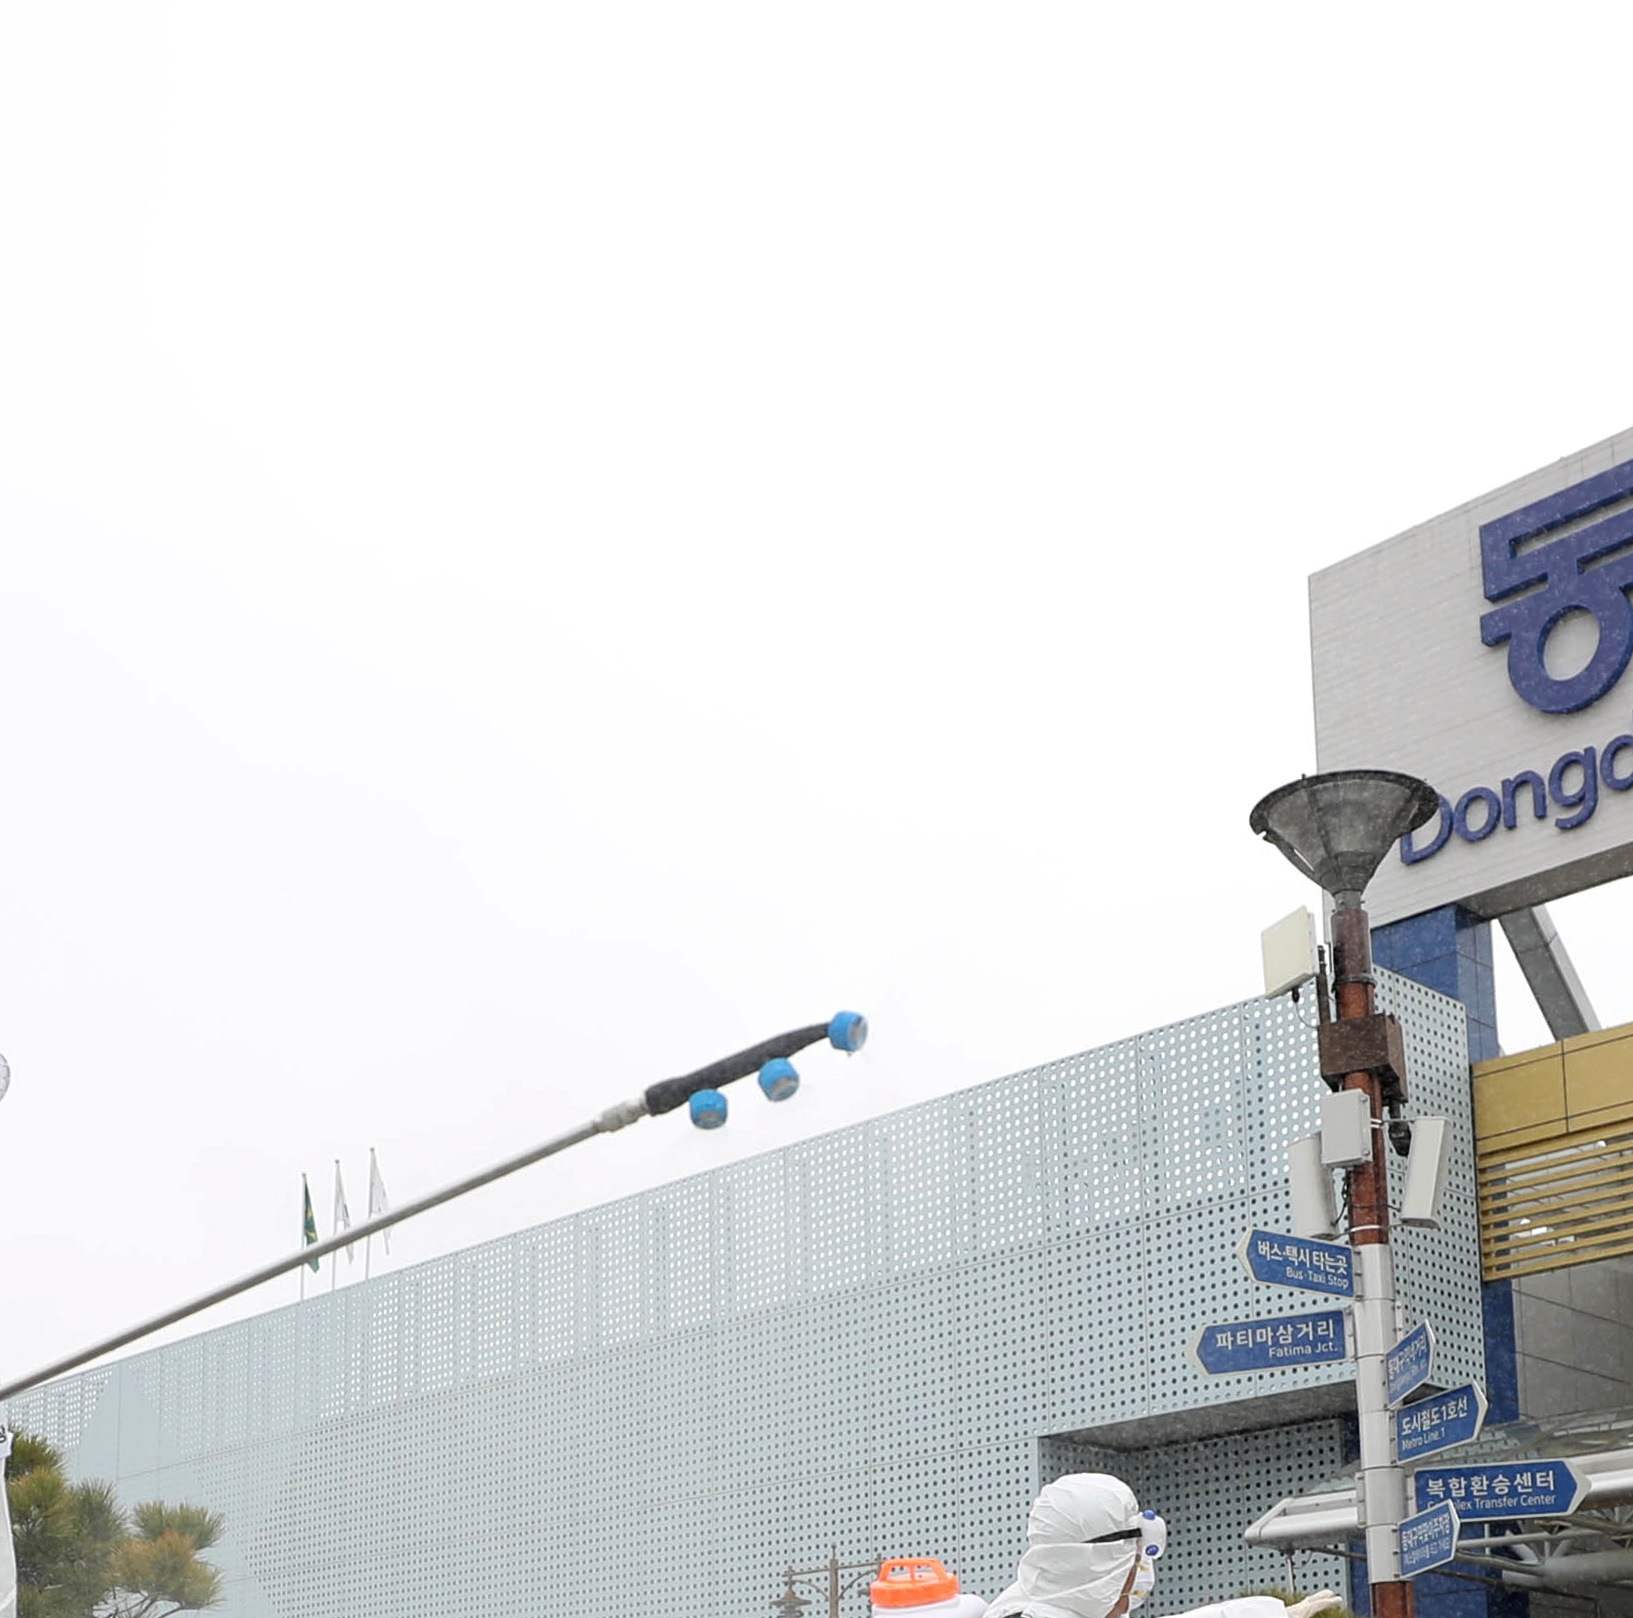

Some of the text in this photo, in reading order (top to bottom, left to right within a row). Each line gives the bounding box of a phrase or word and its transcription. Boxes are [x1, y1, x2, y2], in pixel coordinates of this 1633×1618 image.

[1312, 1250, 1348, 1276] 타는곳
[1328, 1275, 1349, 1290] Stop
[1216, 1318, 1334, 1350] 파티마삼거리
[1269, 1345, 1311, 1358] Fatima
[1401, 1395, 1468, 1435] 도시철도1호선
[1426, 1470, 1555, 1498] 복합환승센터
[1476, 1497, 1517, 1510] Transfer
[1520, 1494, 1556, 1506] Center
